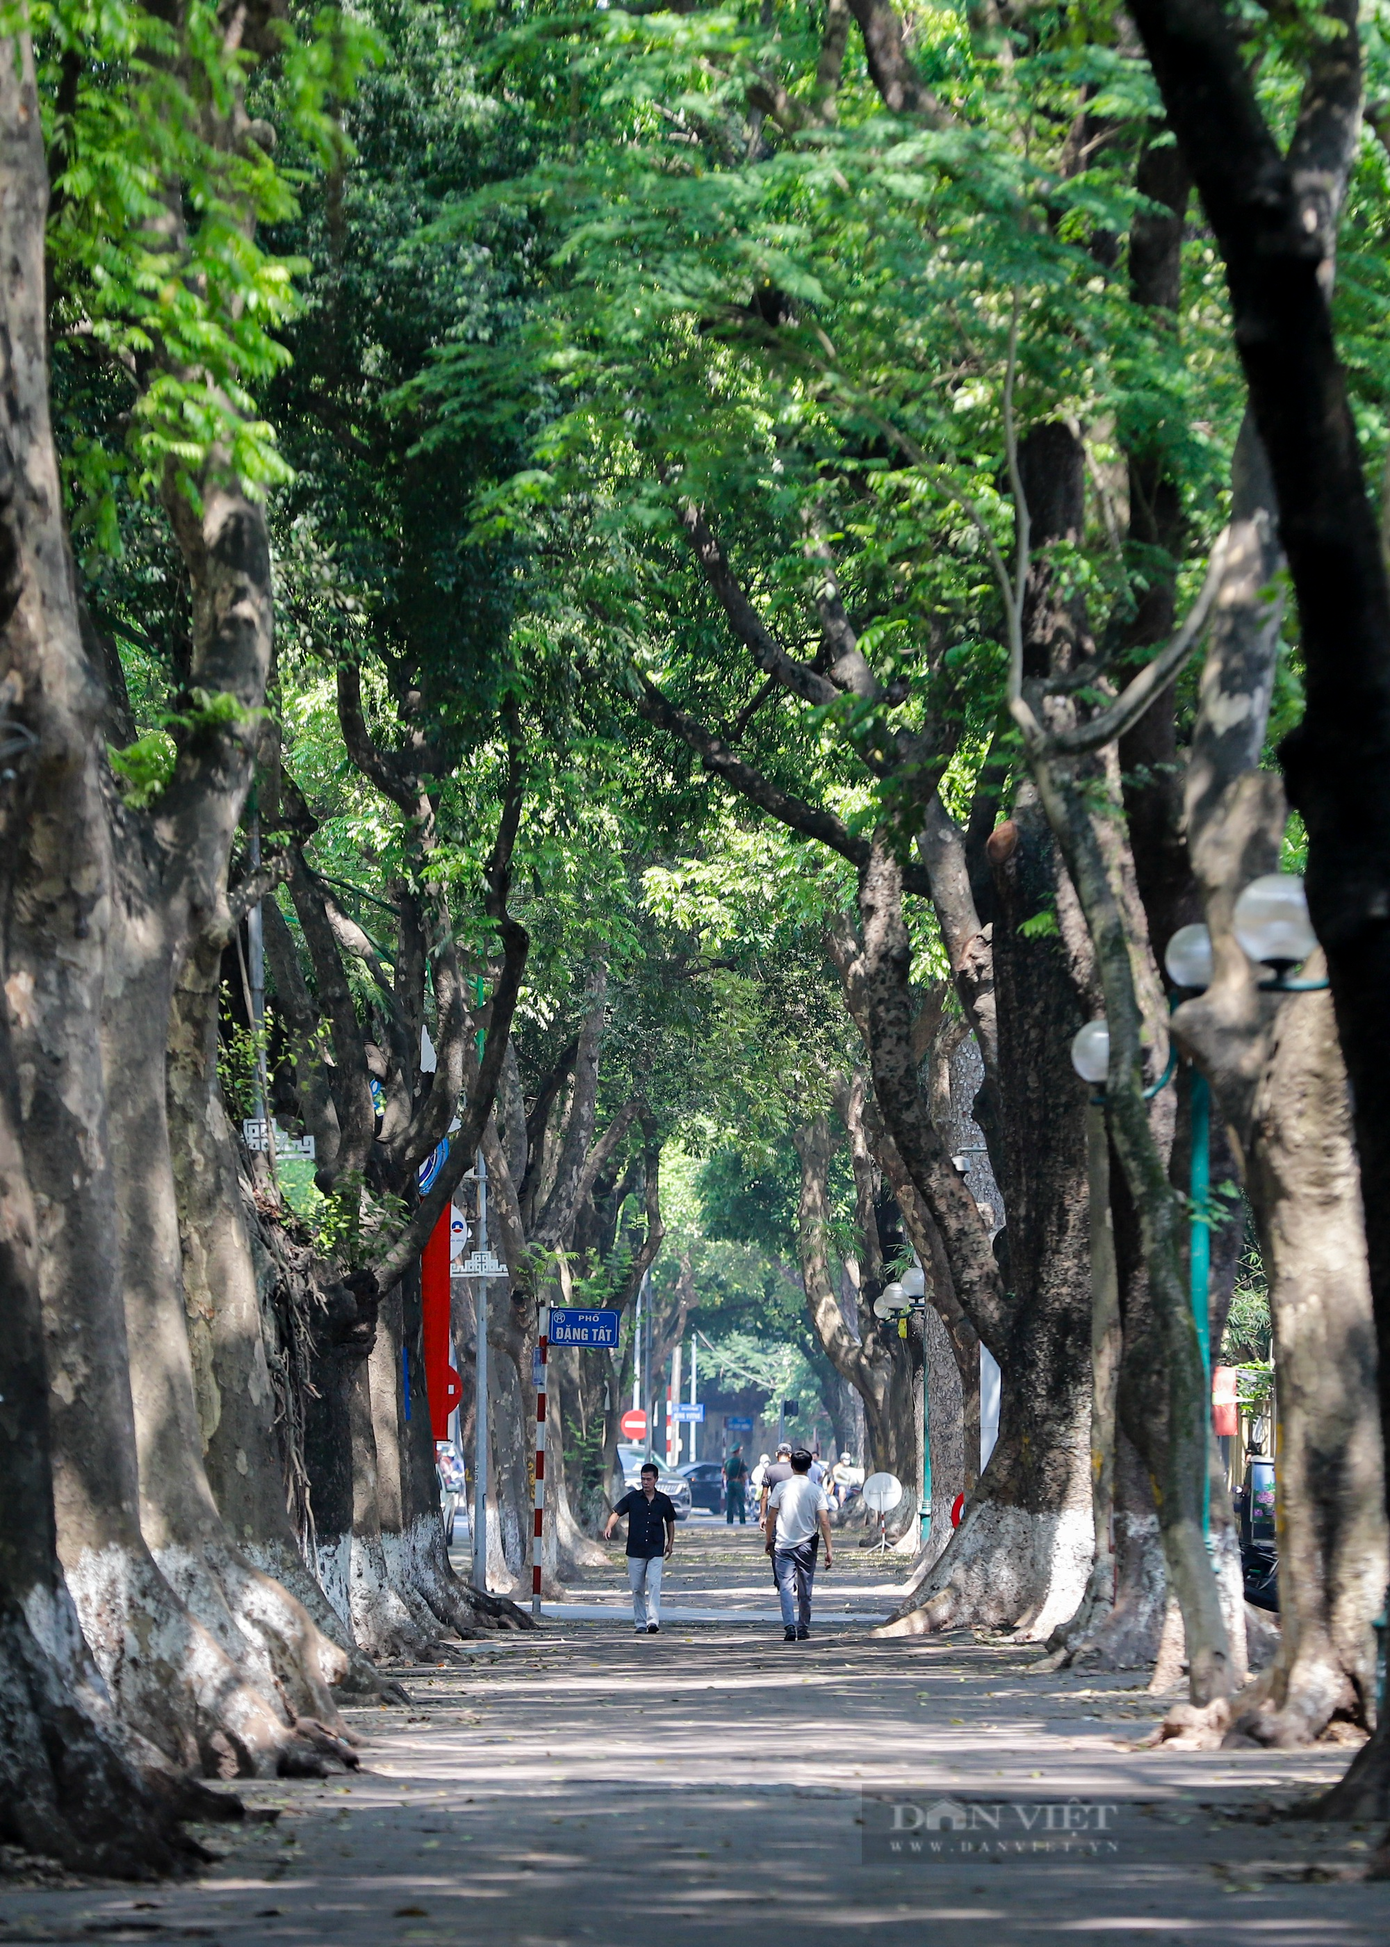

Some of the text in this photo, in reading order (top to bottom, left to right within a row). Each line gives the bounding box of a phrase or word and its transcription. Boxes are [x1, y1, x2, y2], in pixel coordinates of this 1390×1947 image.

[578, 1312, 600, 1322] PHỐ
[556, 1324, 612, 1343] ĐẶNG TẤT
